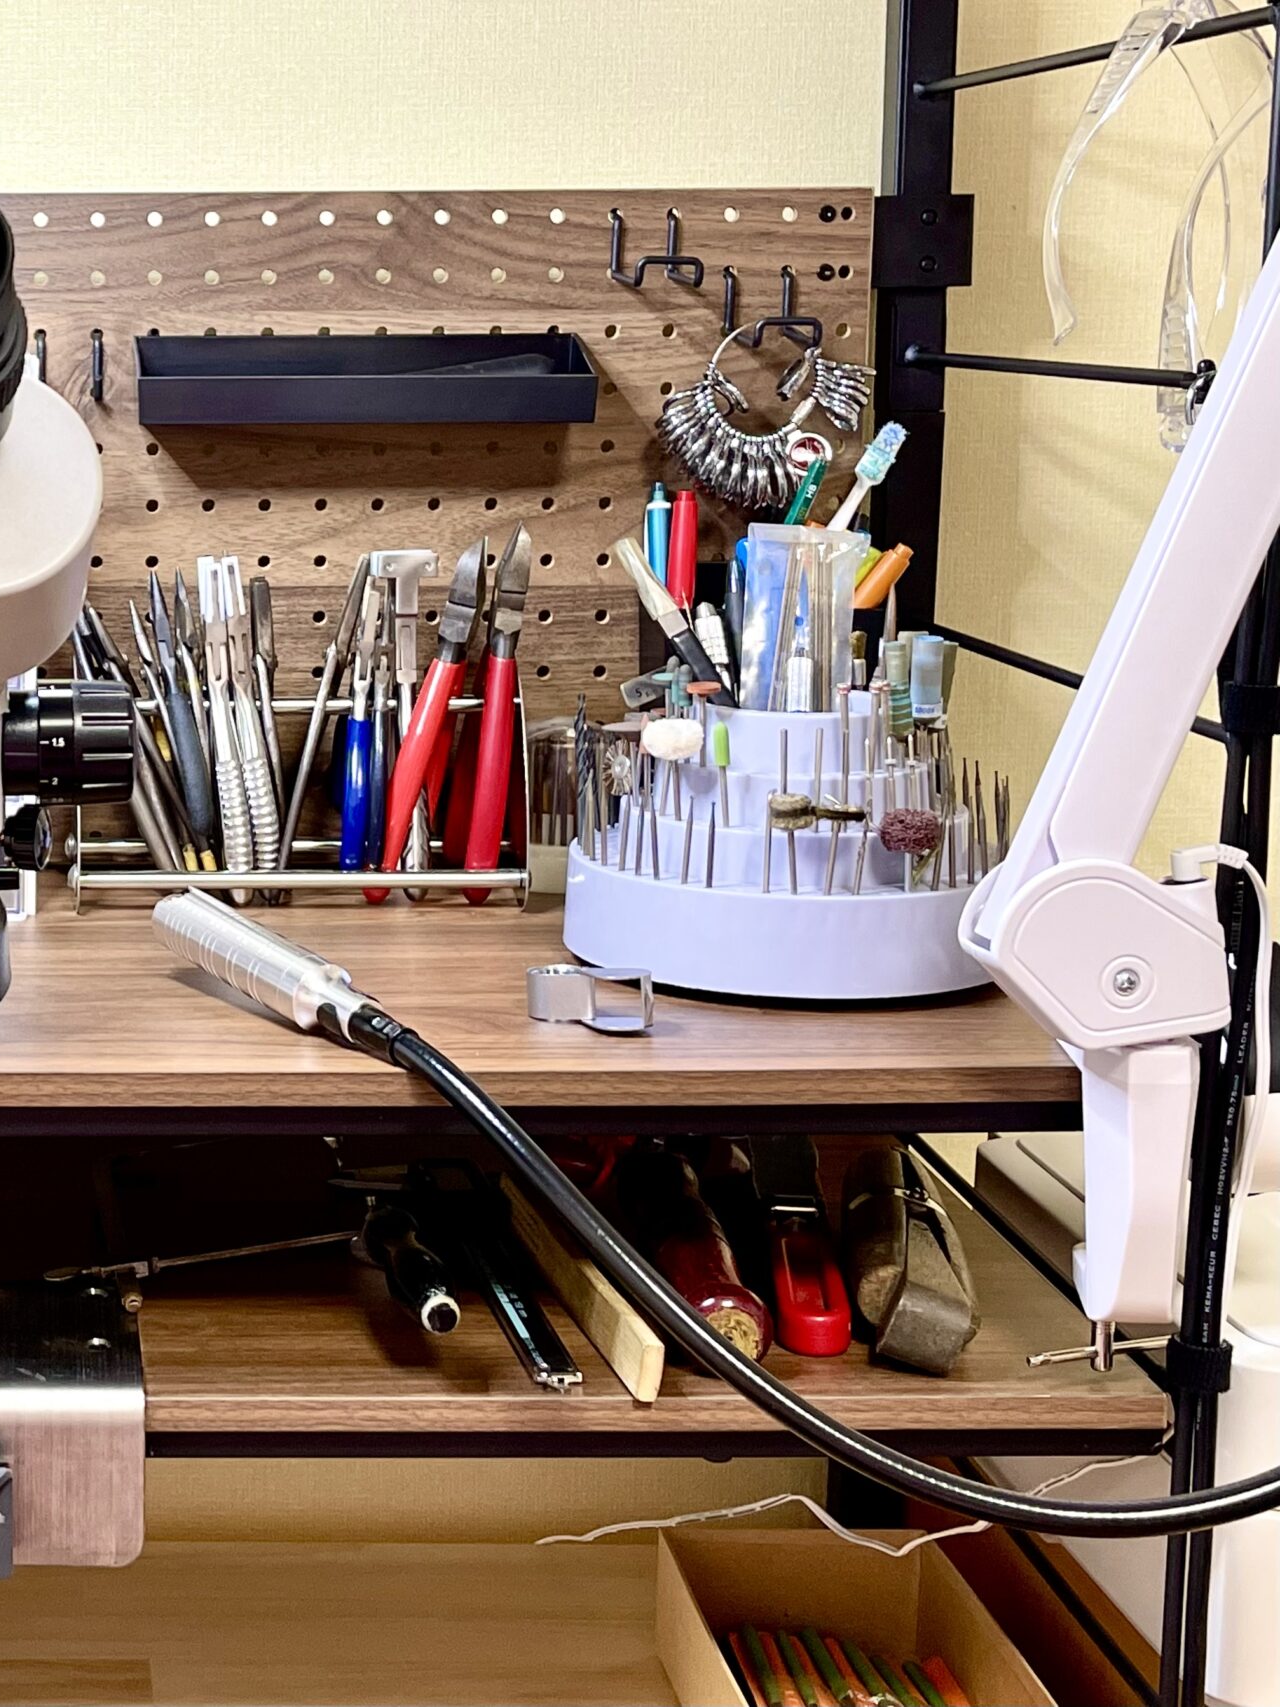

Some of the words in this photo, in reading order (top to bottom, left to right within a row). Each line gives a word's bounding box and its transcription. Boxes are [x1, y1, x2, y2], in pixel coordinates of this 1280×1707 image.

[805, 484, 817, 498] HB
[51, 777, 59, 786] 2
[1237, 1022, 1249, 1064] LEADER
